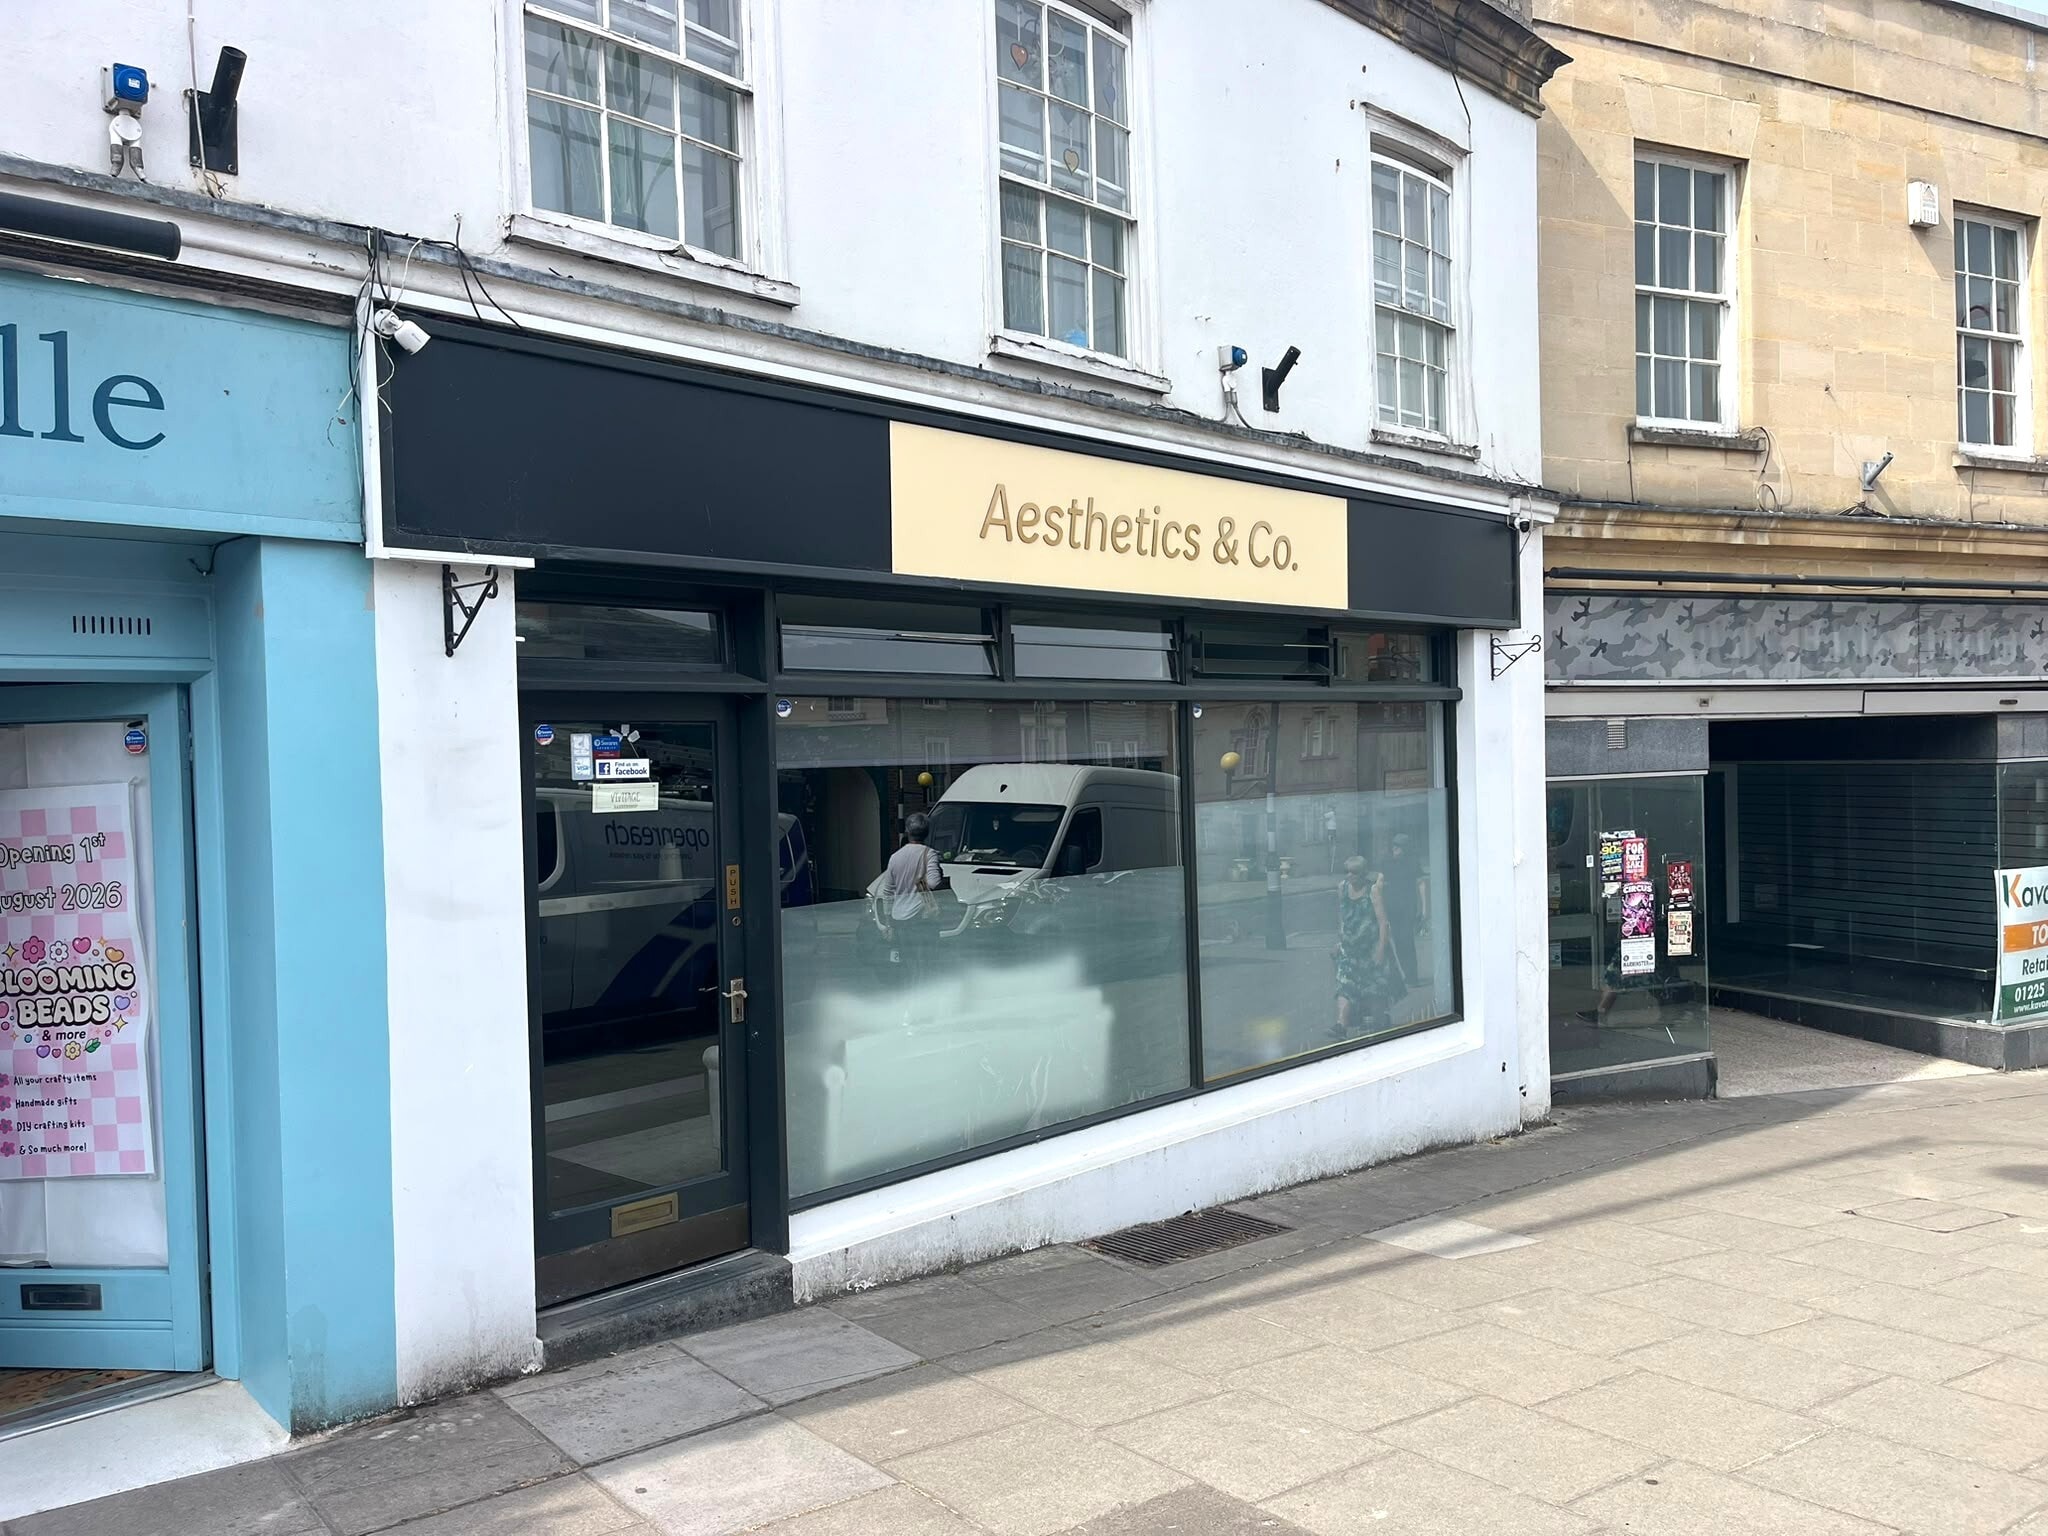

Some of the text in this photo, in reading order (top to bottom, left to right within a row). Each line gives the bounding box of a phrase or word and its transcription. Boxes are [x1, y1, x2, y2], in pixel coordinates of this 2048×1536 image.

[979, 483, 1299, 572] Aesthetics & Co.
[615, 767, 648, 775] facebook
[1625, 842, 1645, 855] FOR
[1622, 884, 1652, 893] CIRCUS
[0, 881, 122, 914] ugust 2026
[2014, 982, 2045, 1003] 01225
[16, 995, 111, 1029] BEADS
[42, 1030, 87, 1041] & more
[13, 1073, 97, 1086] All your crafty items
[15, 1096, 78, 1109] Handmade gifts
[16, 1120, 86, 1132] DIY crafting kits
[19, 1142, 87, 1155] & So much more!
